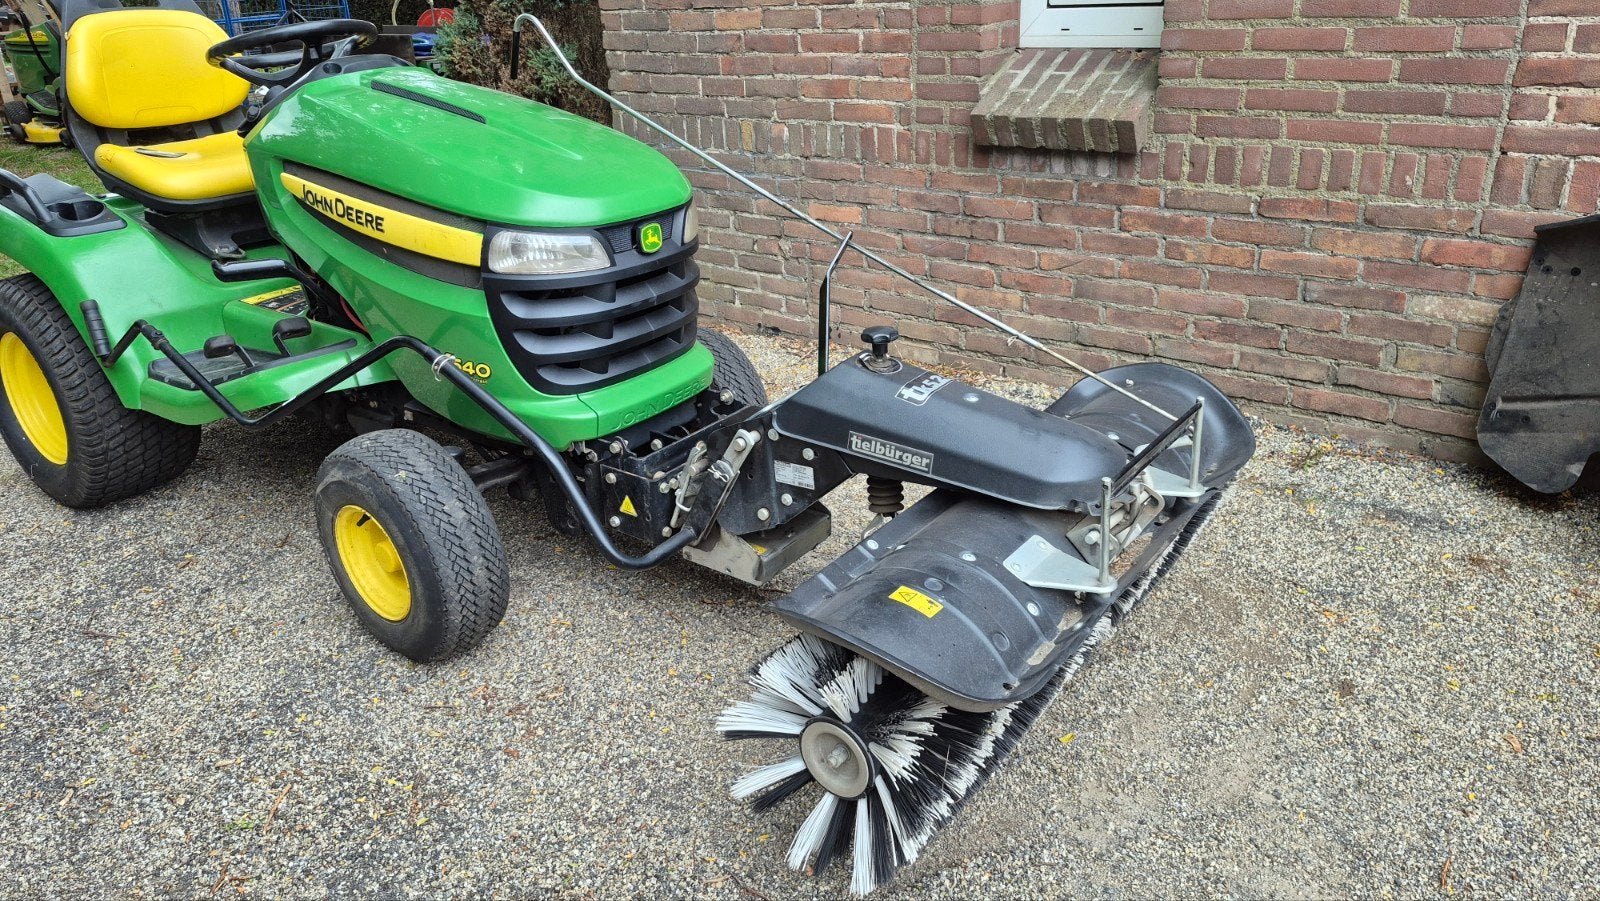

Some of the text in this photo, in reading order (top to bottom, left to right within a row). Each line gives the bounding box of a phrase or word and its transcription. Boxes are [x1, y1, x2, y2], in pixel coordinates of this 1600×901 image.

[301, 183, 385, 233] JOHN DEERE
[443, 352, 491, 378] 540
[612, 400, 658, 431] JOHN
[850, 434, 930, 472] tielbürger
